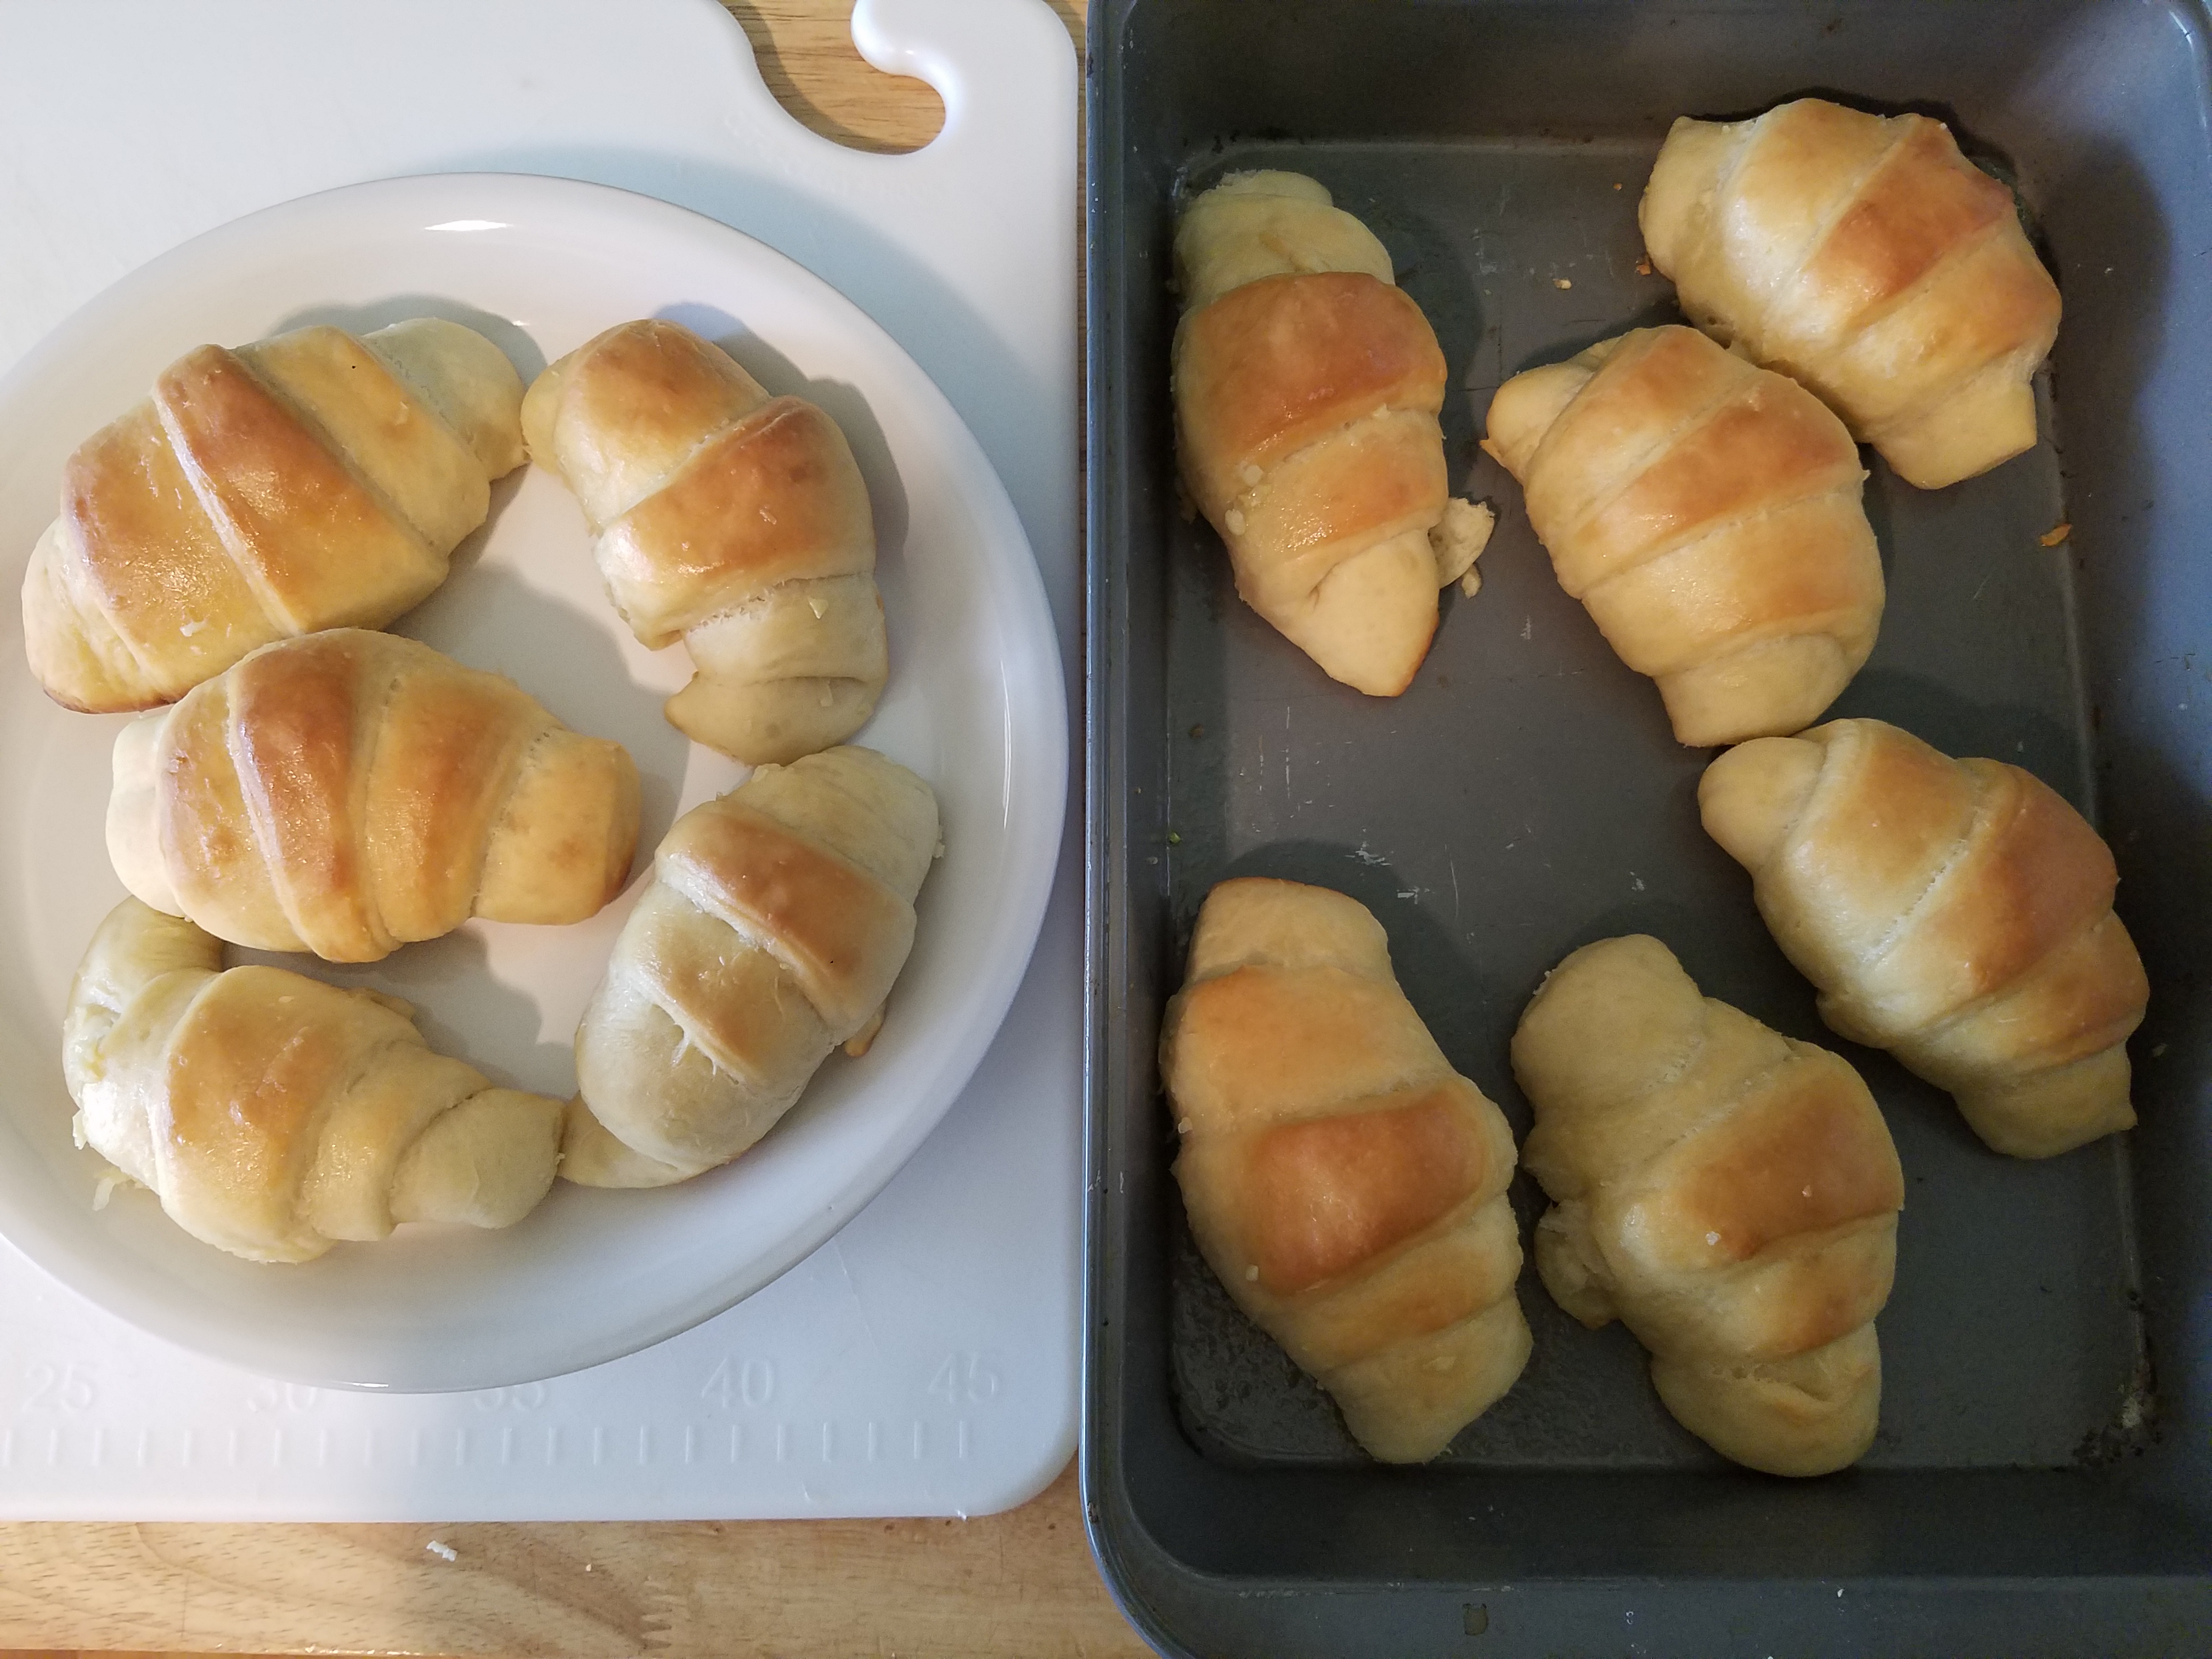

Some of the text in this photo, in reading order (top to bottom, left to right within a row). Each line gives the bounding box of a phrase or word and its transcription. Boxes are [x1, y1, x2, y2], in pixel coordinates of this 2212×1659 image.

[21, 1360, 100, 1417] 25
[701, 1354, 779, 1410] 40
[927, 1348, 1004, 1404] 45
